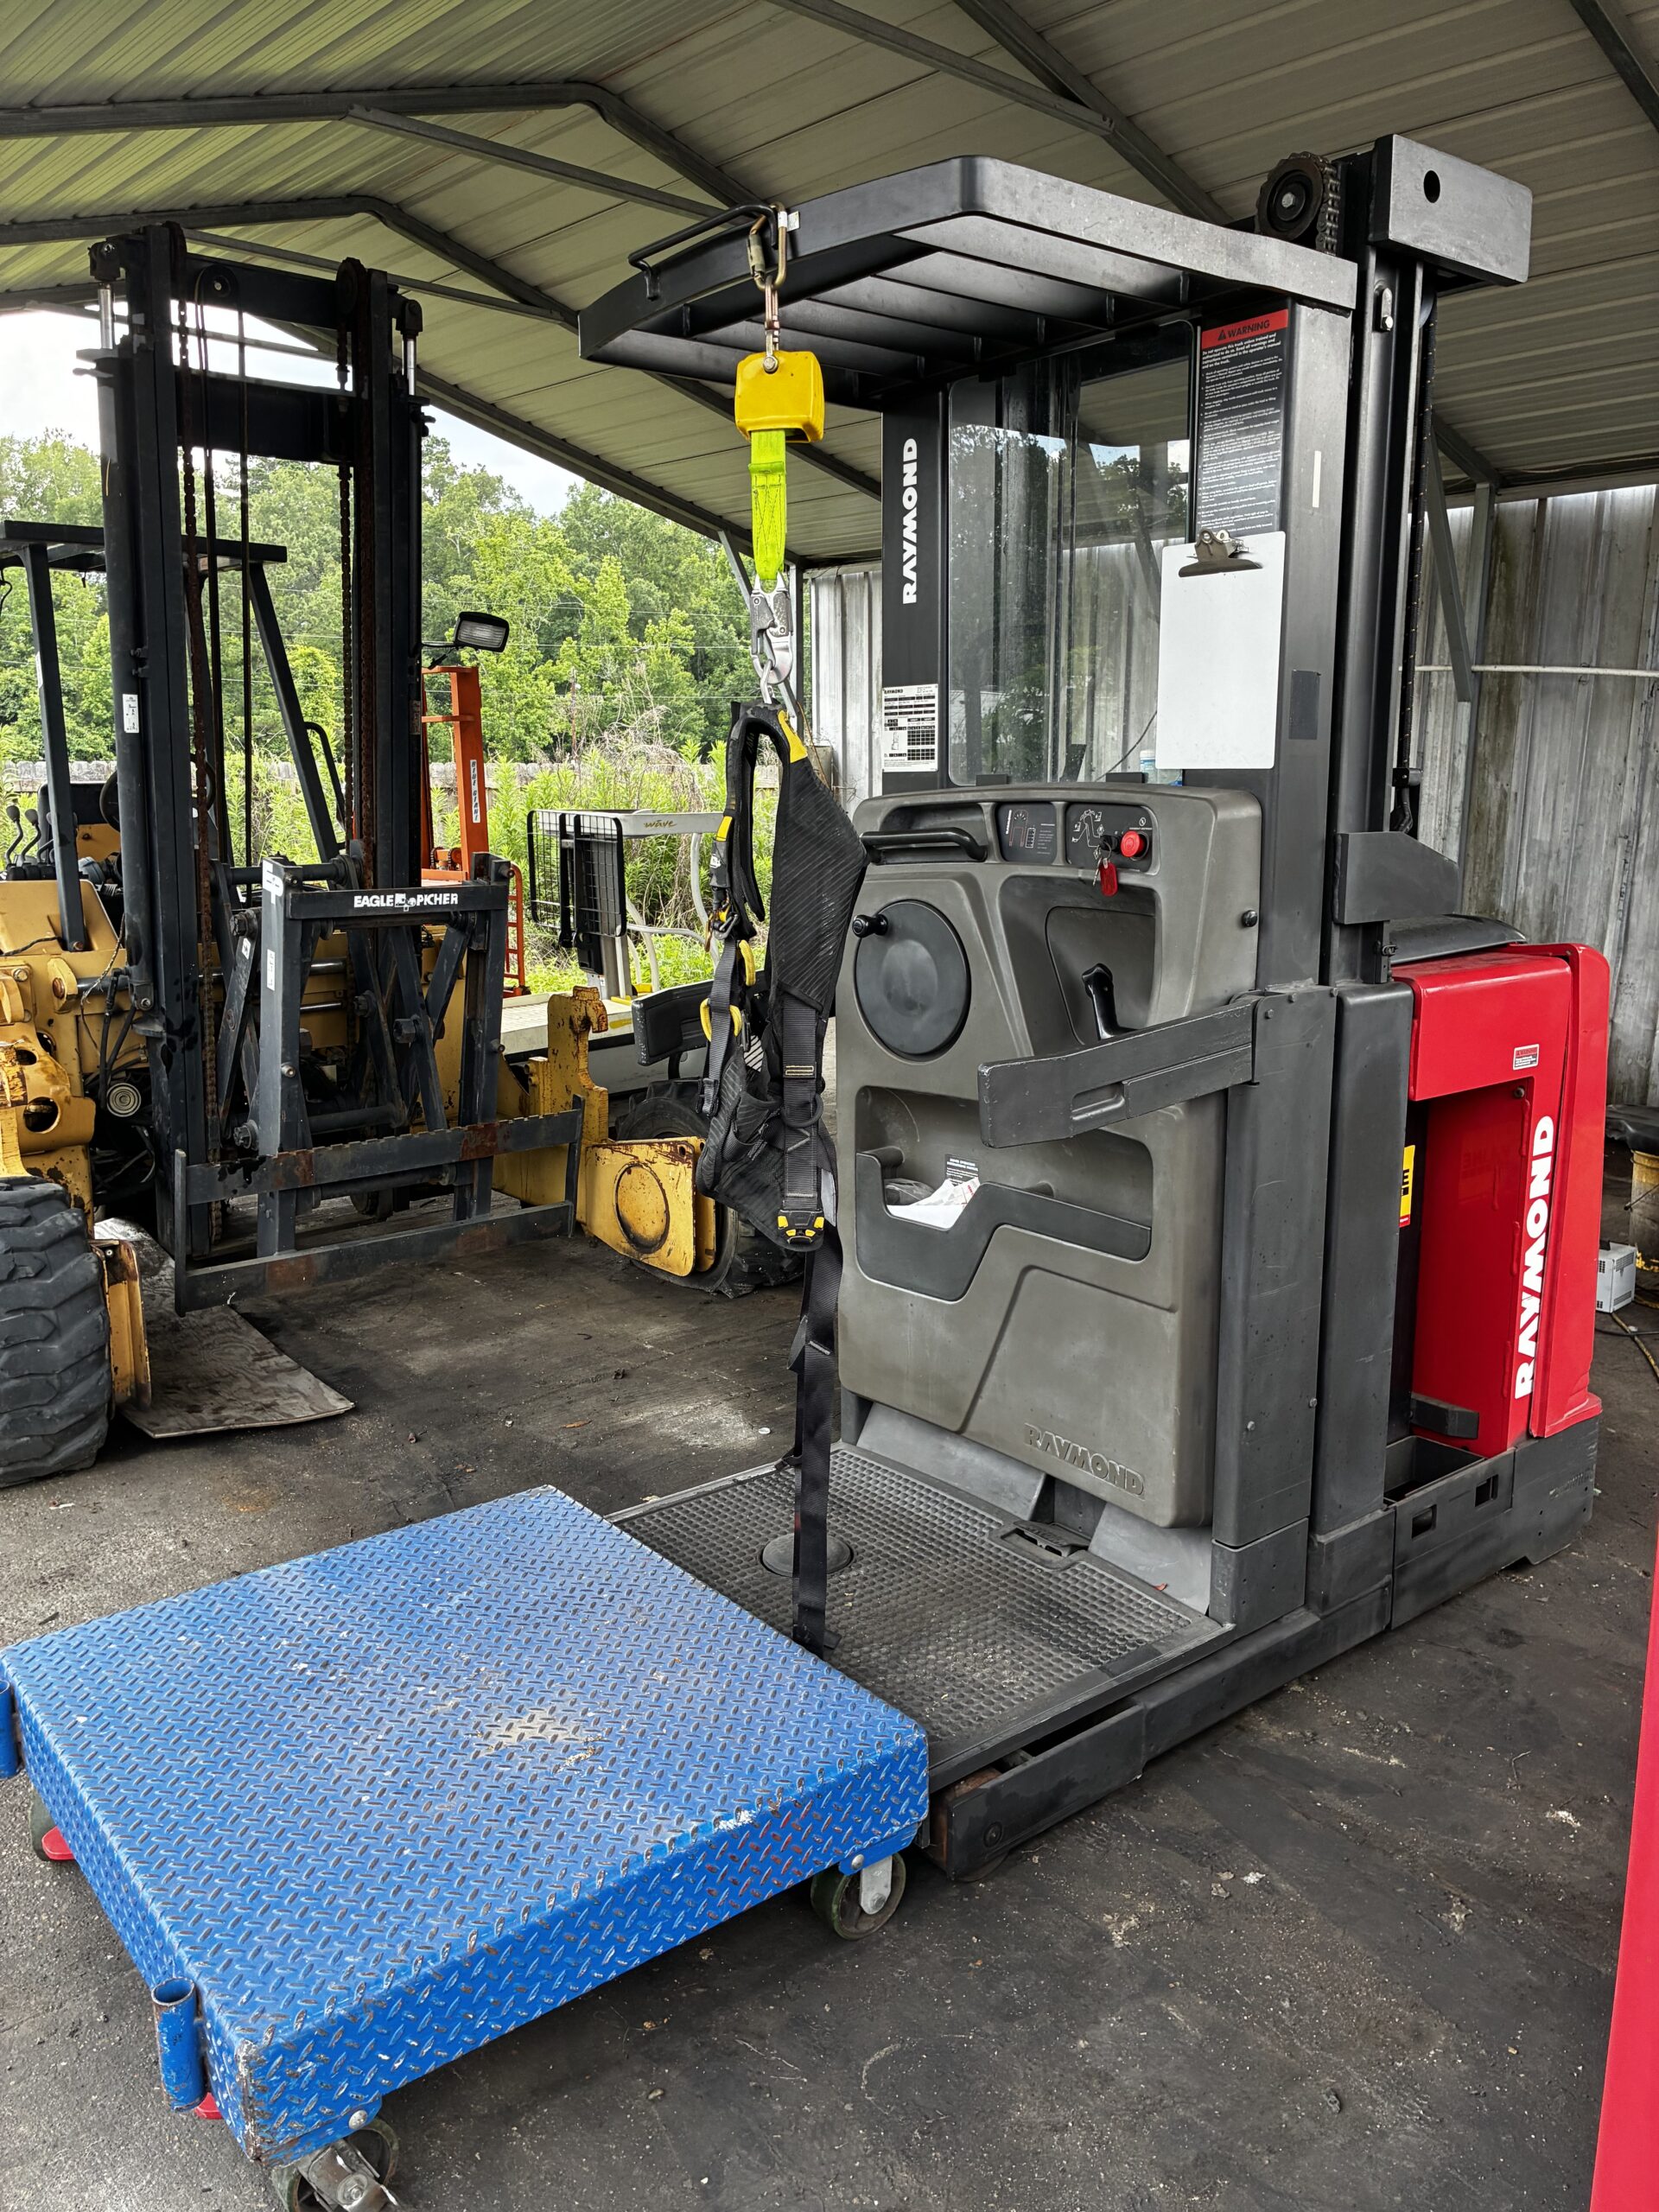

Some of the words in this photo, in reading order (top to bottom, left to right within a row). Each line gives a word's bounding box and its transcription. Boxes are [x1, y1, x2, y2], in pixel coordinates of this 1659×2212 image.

[1228, 320, 1270, 338] WARNING
[902, 438, 918, 604] RAYMOND
[353, 894, 394, 908] EAGLE
[416, 893, 459, 906] PICHER
[1514, 1116, 1554, 1400] RAYMOND
[1025, 1423, 1145, 1497] RAYMOND
